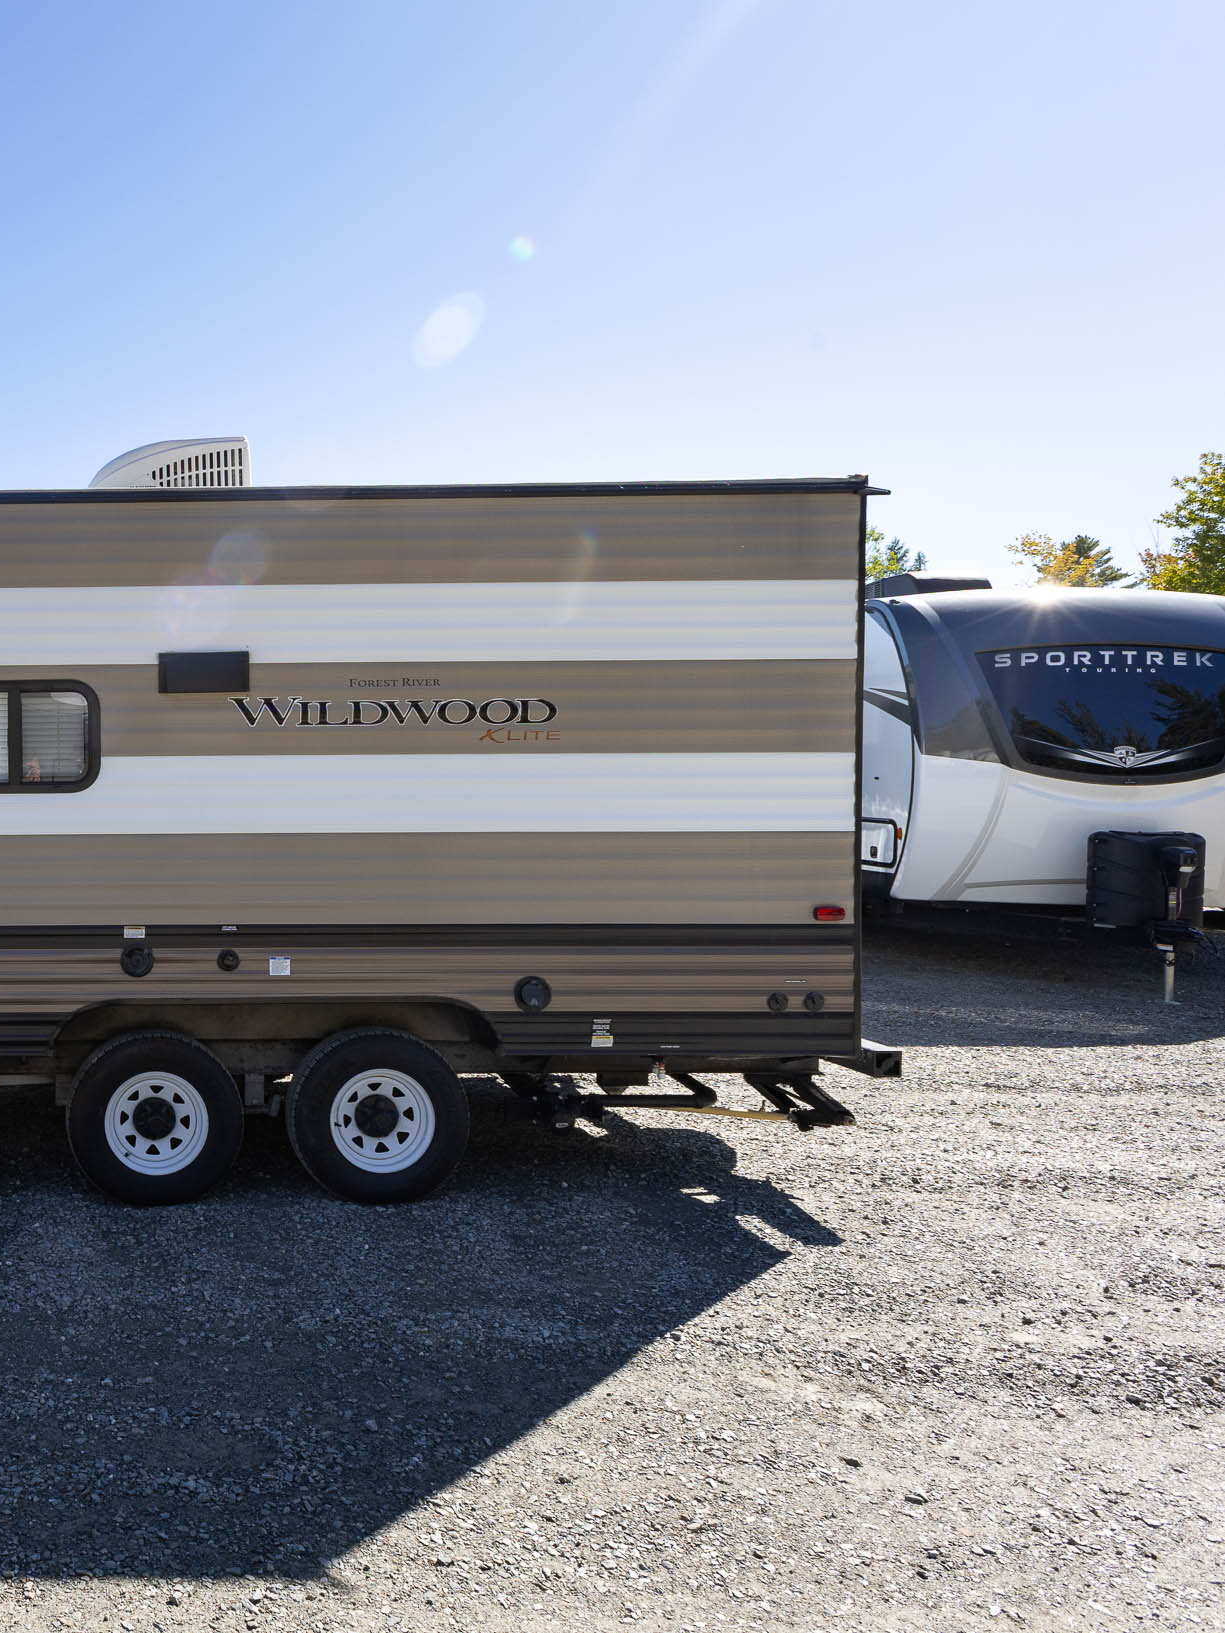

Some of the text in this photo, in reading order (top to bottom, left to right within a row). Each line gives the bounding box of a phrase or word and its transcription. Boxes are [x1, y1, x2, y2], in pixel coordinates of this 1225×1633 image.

[994, 651, 1214, 667] SPORTTREK
[349, 677, 440, 688] FOREST RIVER
[228, 696, 558, 727] WILDWOOD
